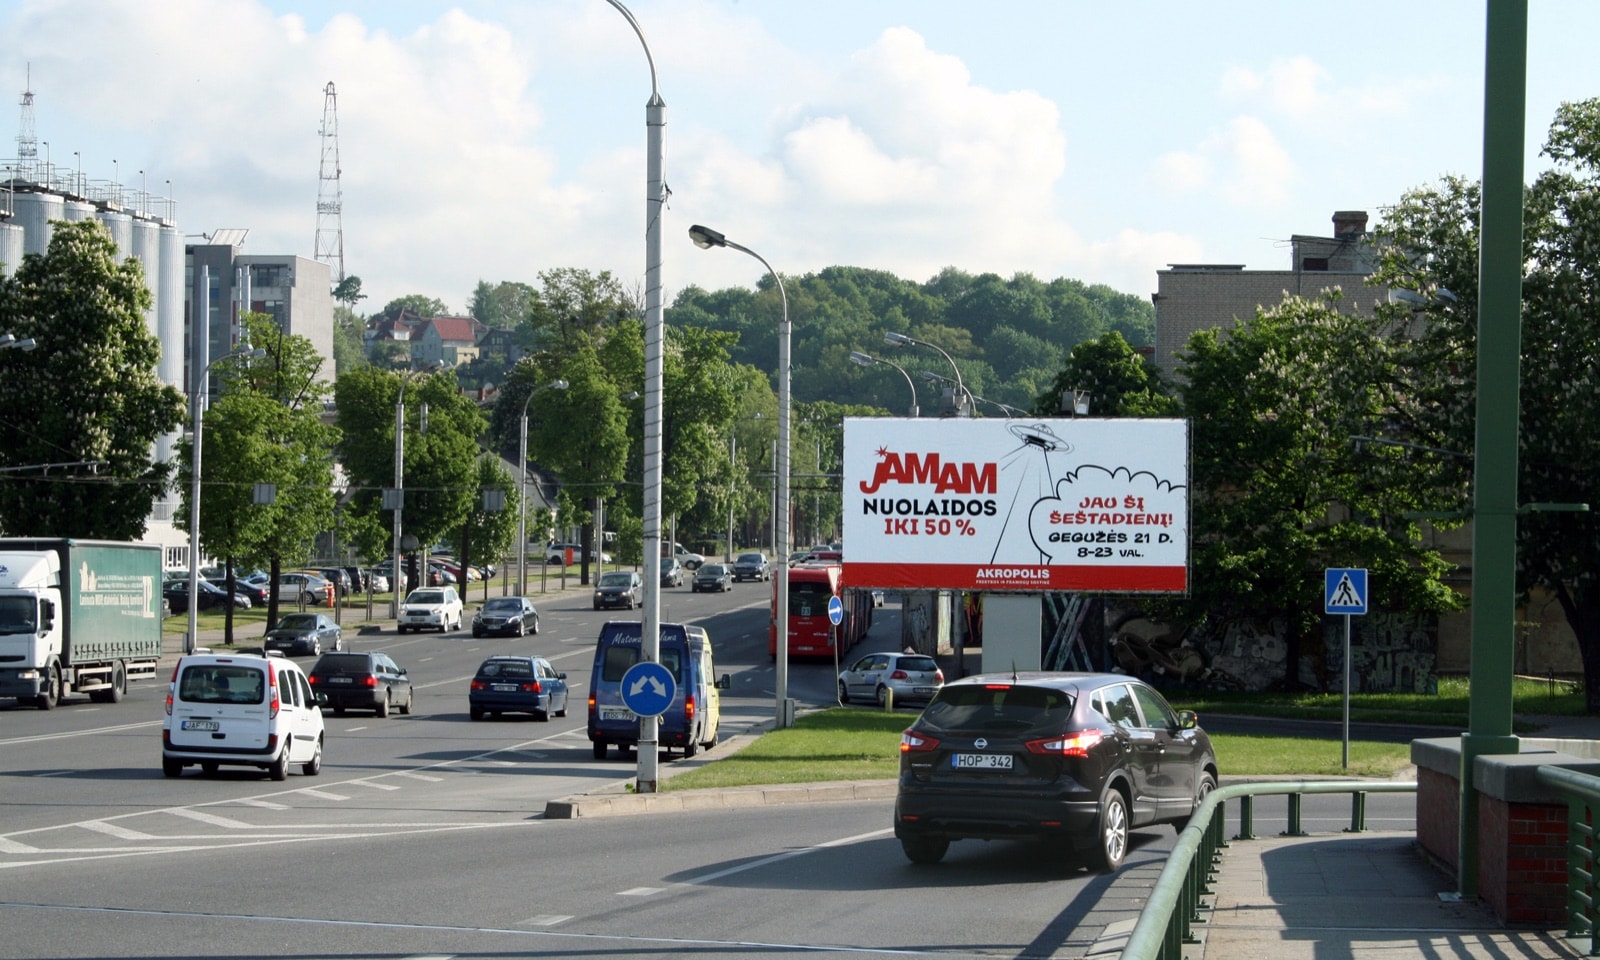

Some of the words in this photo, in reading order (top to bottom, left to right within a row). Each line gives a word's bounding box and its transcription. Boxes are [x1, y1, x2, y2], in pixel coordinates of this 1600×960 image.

[860, 450, 997, 494] JAMAM
[863, 498, 997, 516] NUOLAIDOS
[1079, 497, 1117, 509] JAU
[1124, 495, 1144, 512] ŠĮ
[884, 518, 919, 535] IKI
[925, 518, 951, 536] 50
[1049, 510, 1173, 528] ŠEŠTADIENĮ!
[1048, 529, 1128, 543] GEGUŽĖS
[1134, 533, 1150, 544] 21
[1158, 533, 1173, 544] D.
[1077, 547, 1113, 558] 8-23
[1119, 549, 1144, 558] VAL.
[976, 569, 1050, 579] AKROPOLIS
[958, 755, 983, 767] HOP
[990, 756, 1011, 768] 342
